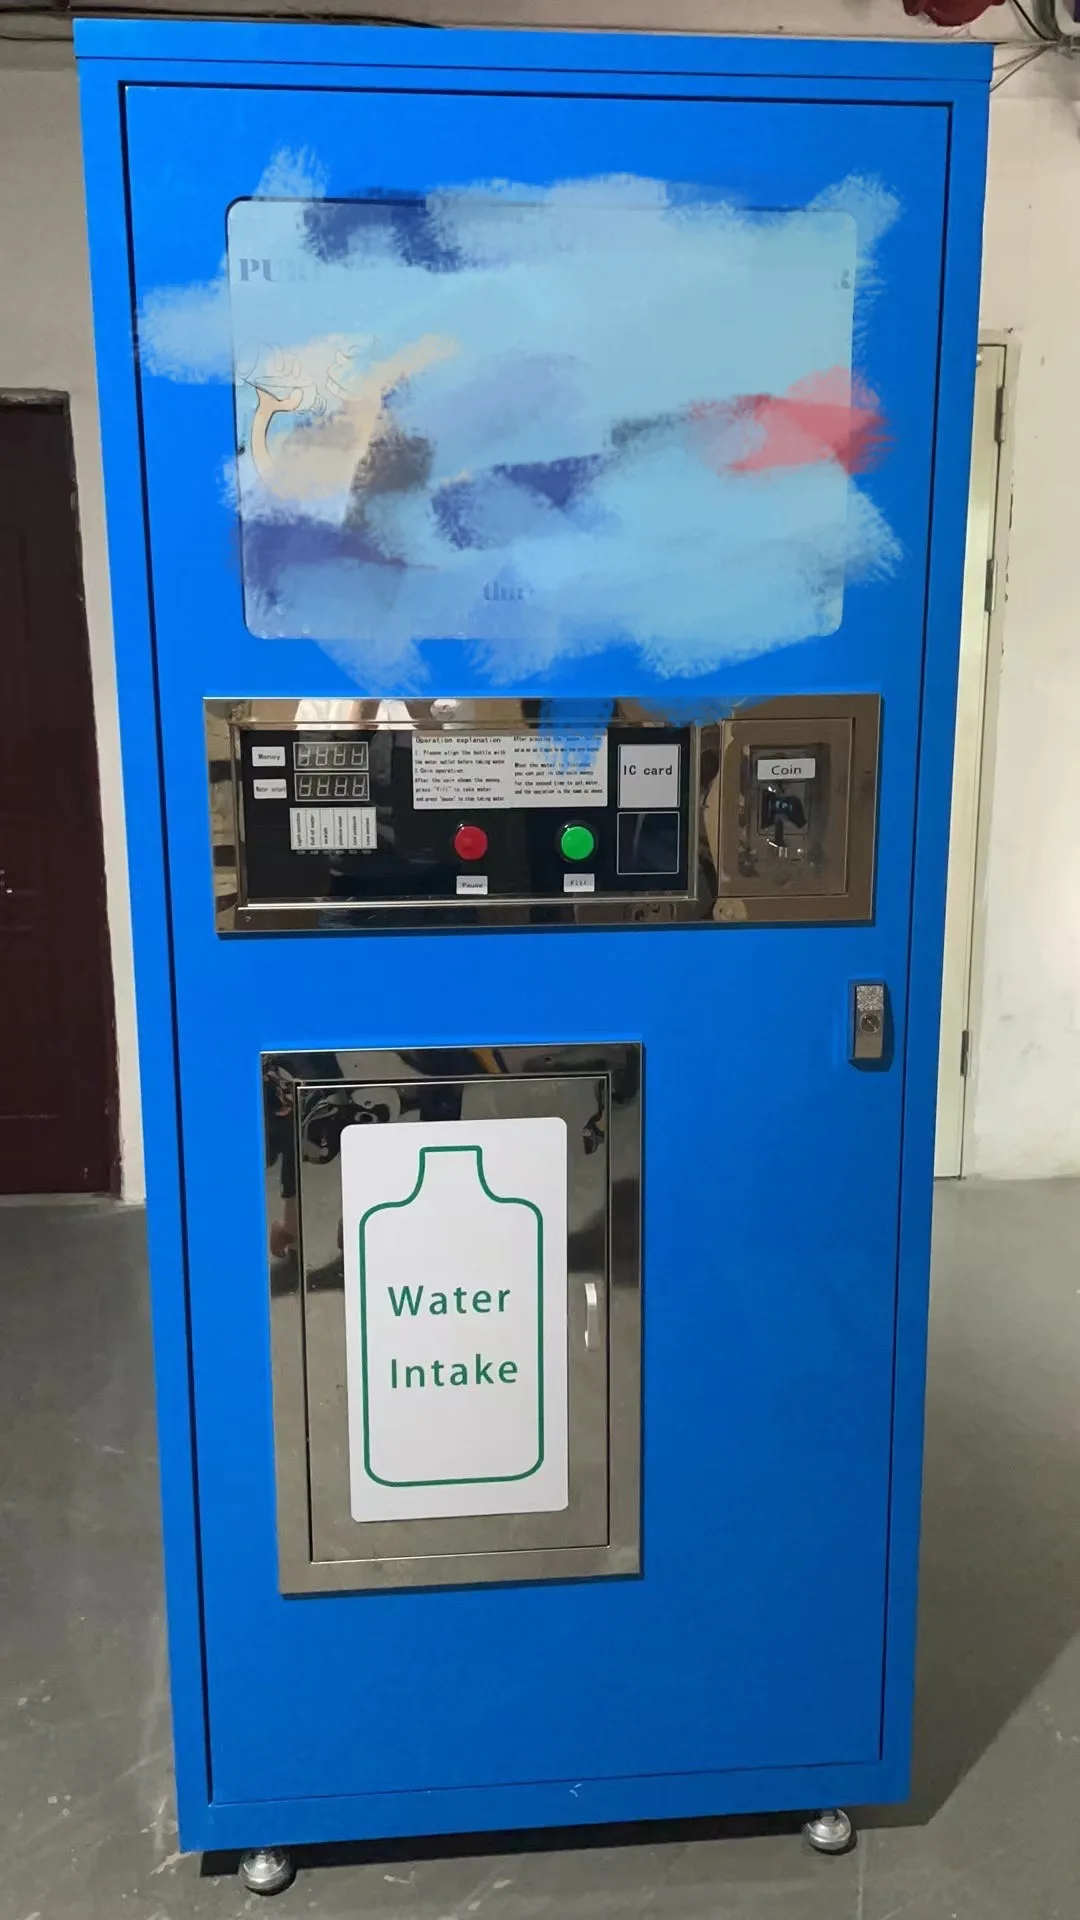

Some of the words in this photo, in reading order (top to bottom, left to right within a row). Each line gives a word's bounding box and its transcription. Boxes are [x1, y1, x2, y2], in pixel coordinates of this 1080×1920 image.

[624, 765, 637, 776] IC
[643, 764, 673, 776] card
[771, 764, 802, 776] Coin
[388, 1285, 511, 1316] Water
[391, 1353, 518, 1389] Intake
